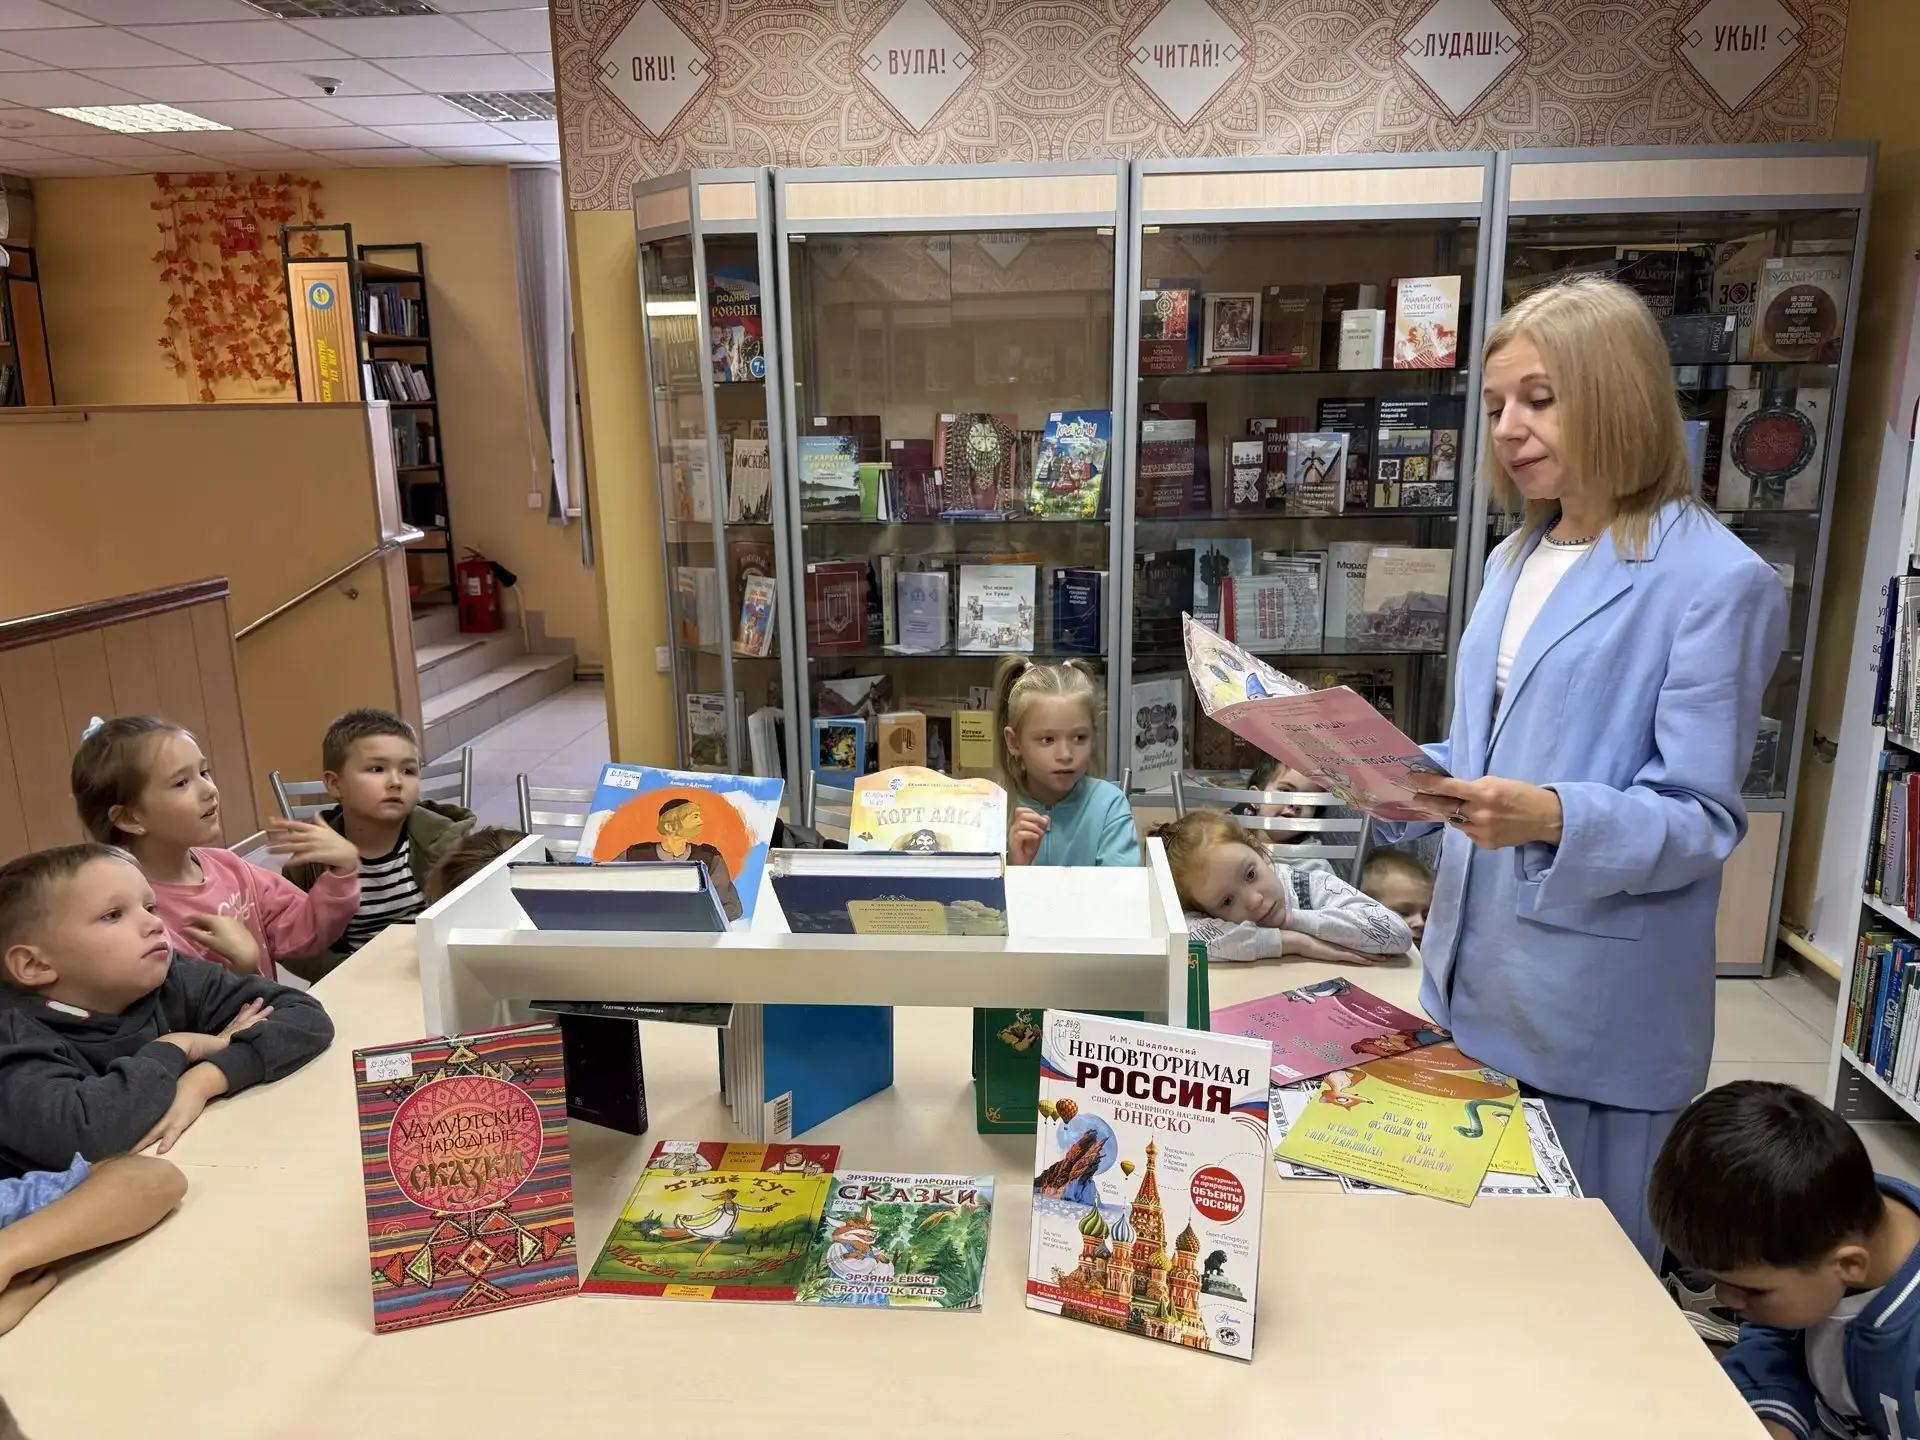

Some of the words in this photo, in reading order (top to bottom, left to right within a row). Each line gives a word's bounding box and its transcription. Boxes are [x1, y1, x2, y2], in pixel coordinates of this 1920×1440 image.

[1423, 30, 1501, 61] ЛУДАШ!
[1712, 25, 1768, 53] УКЫ!
[888, 48, 947, 75] ВУЛА!
[1153, 38, 1221, 69] ЧИТАЙ!
[711, 304, 757, 317] РОССИЯ
[875, 807, 925, 826] КОРТ
[928, 805, 982, 828] АЙКА
[1109, 1034, 1131, 1045] И.М.
[1136, 1039, 1197, 1056] Шидловский
[1068, 1039, 1250, 1087] НЕПОВТОРИМАЯ
[1076, 1061, 1232, 1114] РОССИЯ
[1091, 1095, 1123, 1107] СПИСОК
[1124, 1100, 1175, 1117] ВСЕМИРНОГО
[1176, 1110, 1216, 1124] НАСЛЕДИЯ
[1114, 1107, 1192, 1135] ЮНЕСКО
[846, 1174, 911, 1184] ЭРЗЯНСКИЕ
[915, 1178, 976, 1186] НАРОДНЫЕ
[1200, 1174, 1238, 1186] культурные
[1200, 1180, 1242, 1193] природные
[838, 1185, 978, 1205] СКАЗКИ
[1195, 1196, 1240, 1213] РОССИИ
[845, 1273, 894, 1283] ЭРЗЯНЬ
[899, 1273, 937, 1284] ЁВКСТ
[832, 1285, 873, 1294] ERZYA
[874, 1286, 905, 1295] FOLK
[909, 1287, 945, 1296] TALES
[1037, 1284, 1127, 1311] РЕКОМЕНДОВАНО
